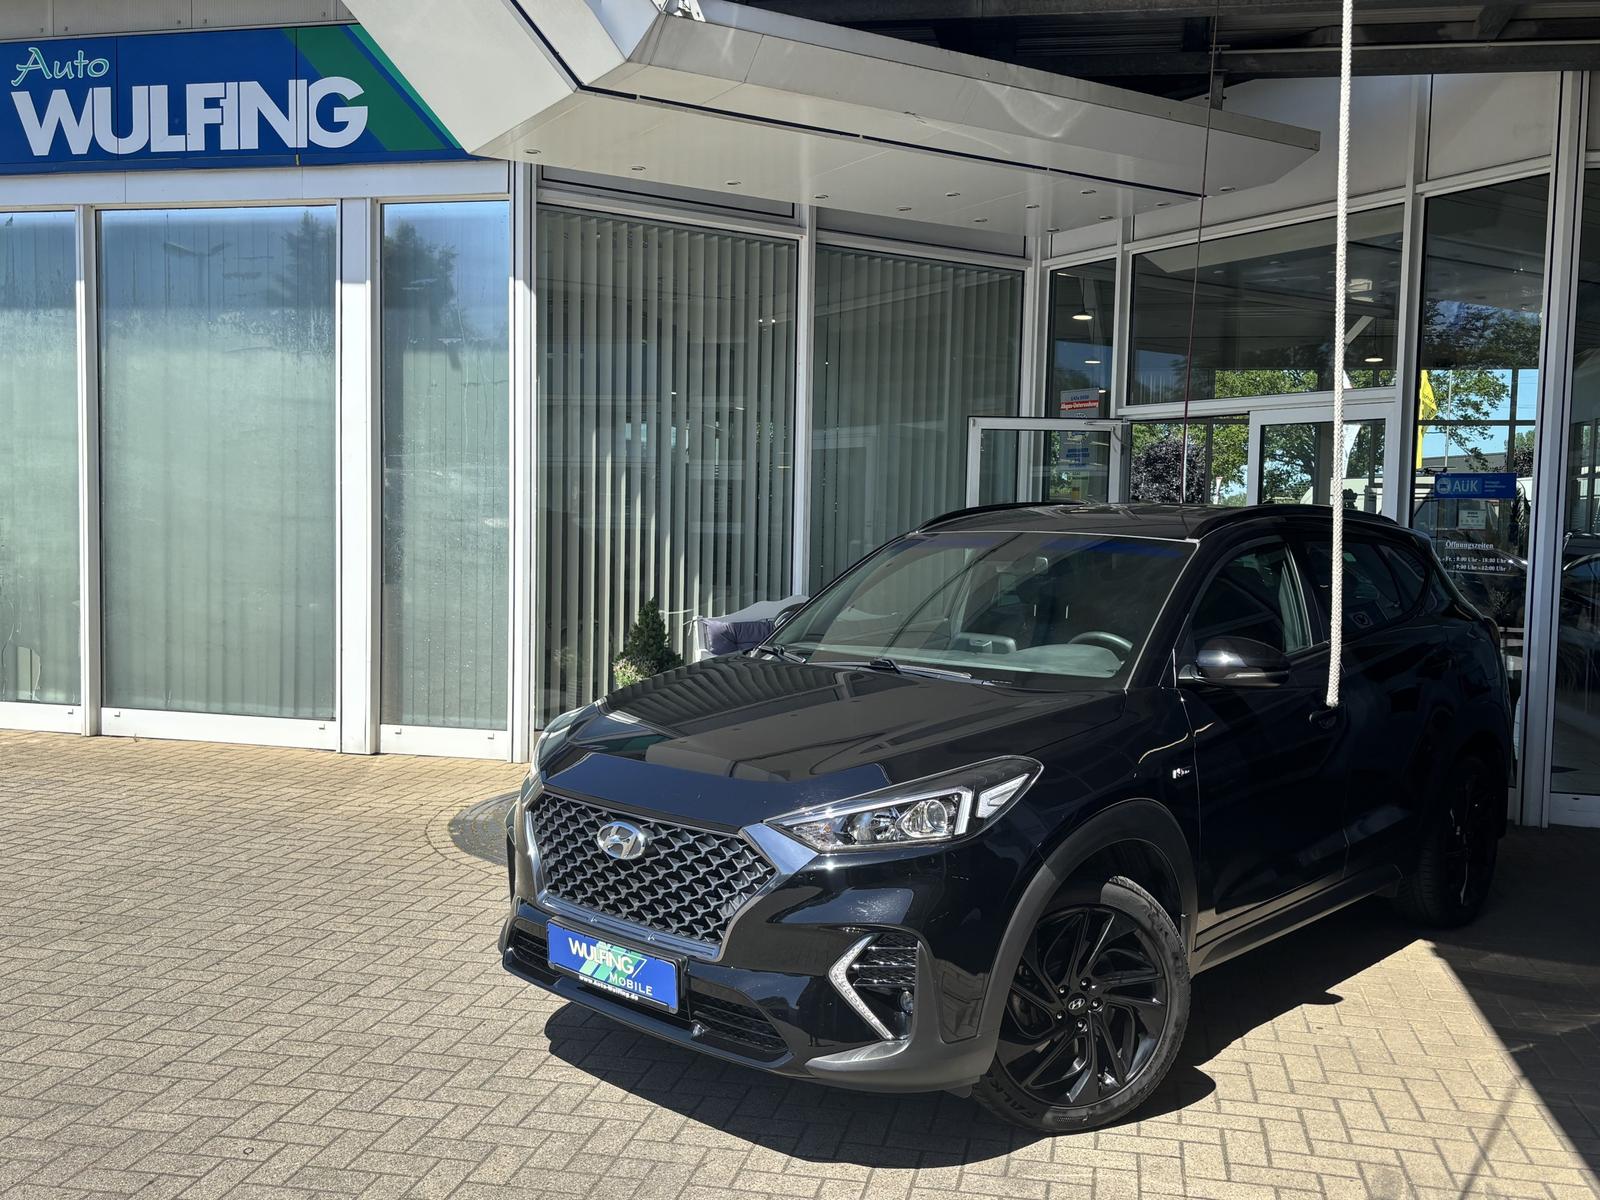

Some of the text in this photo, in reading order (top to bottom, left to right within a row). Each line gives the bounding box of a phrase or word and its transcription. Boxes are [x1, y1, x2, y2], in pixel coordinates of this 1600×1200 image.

[11, 46, 110, 87] Auto
[11, 76, 368, 156] WULFING
[1445, 540, 1494, 550] Öffnungszeiten
[609, 972, 653, 996] MOBILE
